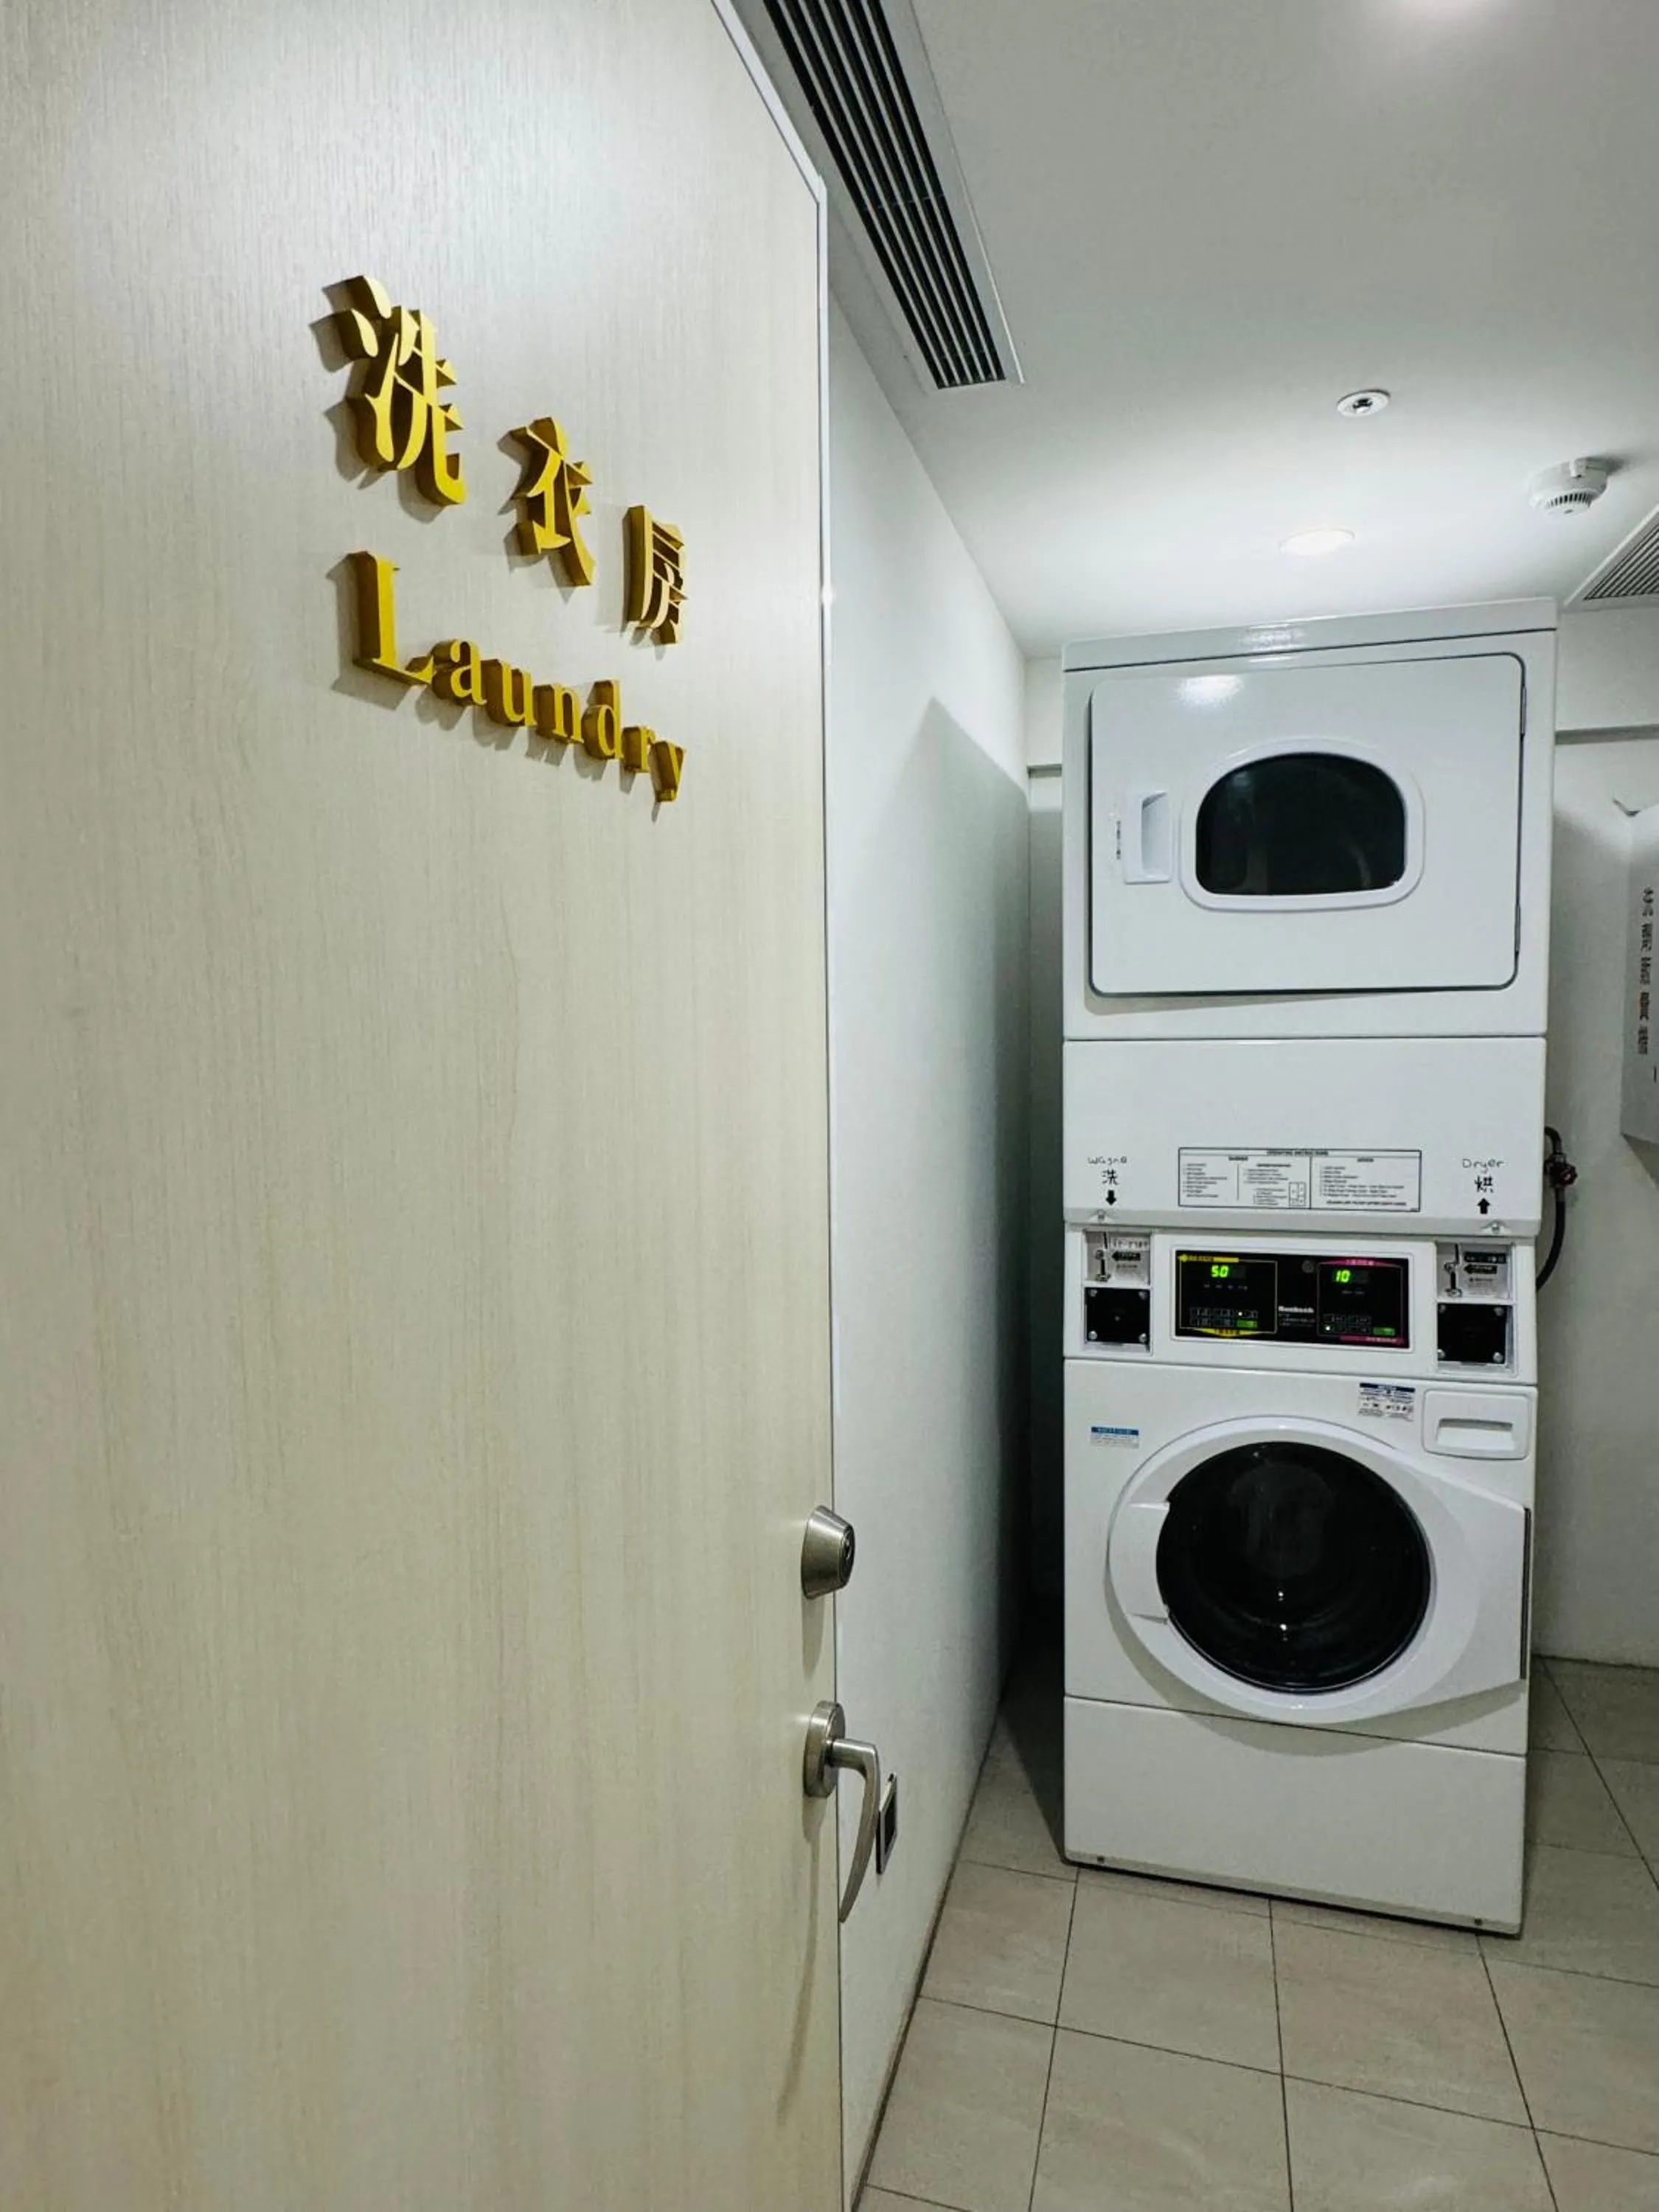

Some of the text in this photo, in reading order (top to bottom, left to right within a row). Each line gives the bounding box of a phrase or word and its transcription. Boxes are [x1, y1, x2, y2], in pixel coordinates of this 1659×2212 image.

[336, 276, 688, 644] 洗衣房
[352, 551, 686, 802] Laundry
[1462, 1158, 1505, 1174] Dryer
[1102, 1169, 1119, 1186] 洗
[1474, 1175, 1493, 1192] 烘
[1211, 1265, 1229, 1278] 50
[1335, 1270, 1351, 1283] 10
